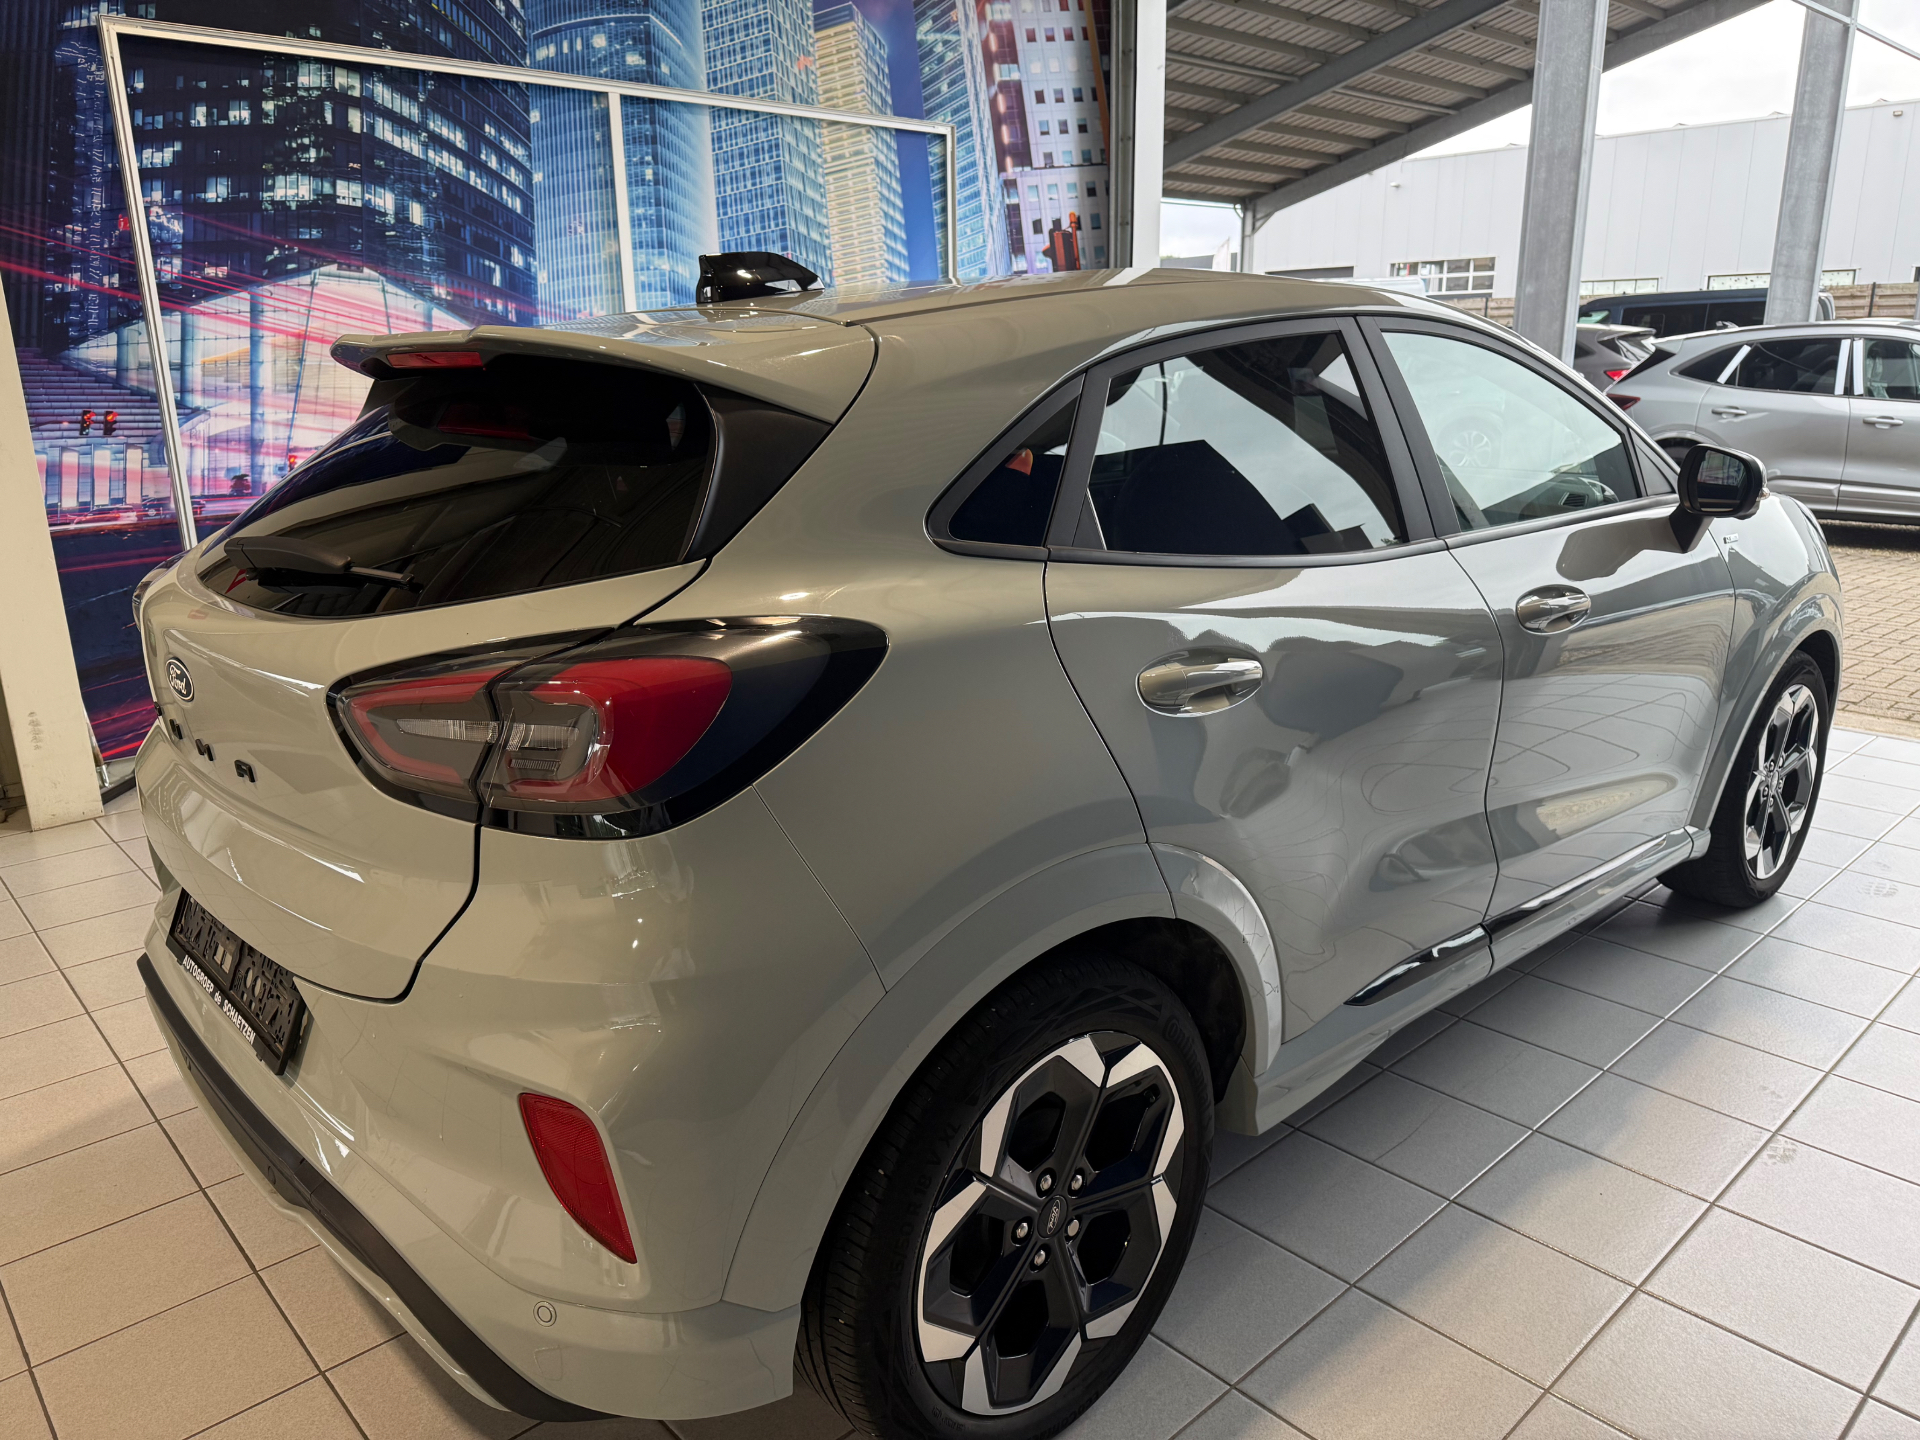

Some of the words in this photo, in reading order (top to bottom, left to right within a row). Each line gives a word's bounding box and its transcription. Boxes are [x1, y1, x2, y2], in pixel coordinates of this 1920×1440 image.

[169, 665, 187, 695] Ford
[182, 954, 214, 994] AUTOGROEP
[213, 991, 222, 1006] de
[222, 999, 256, 1045] SCHAETZEN
